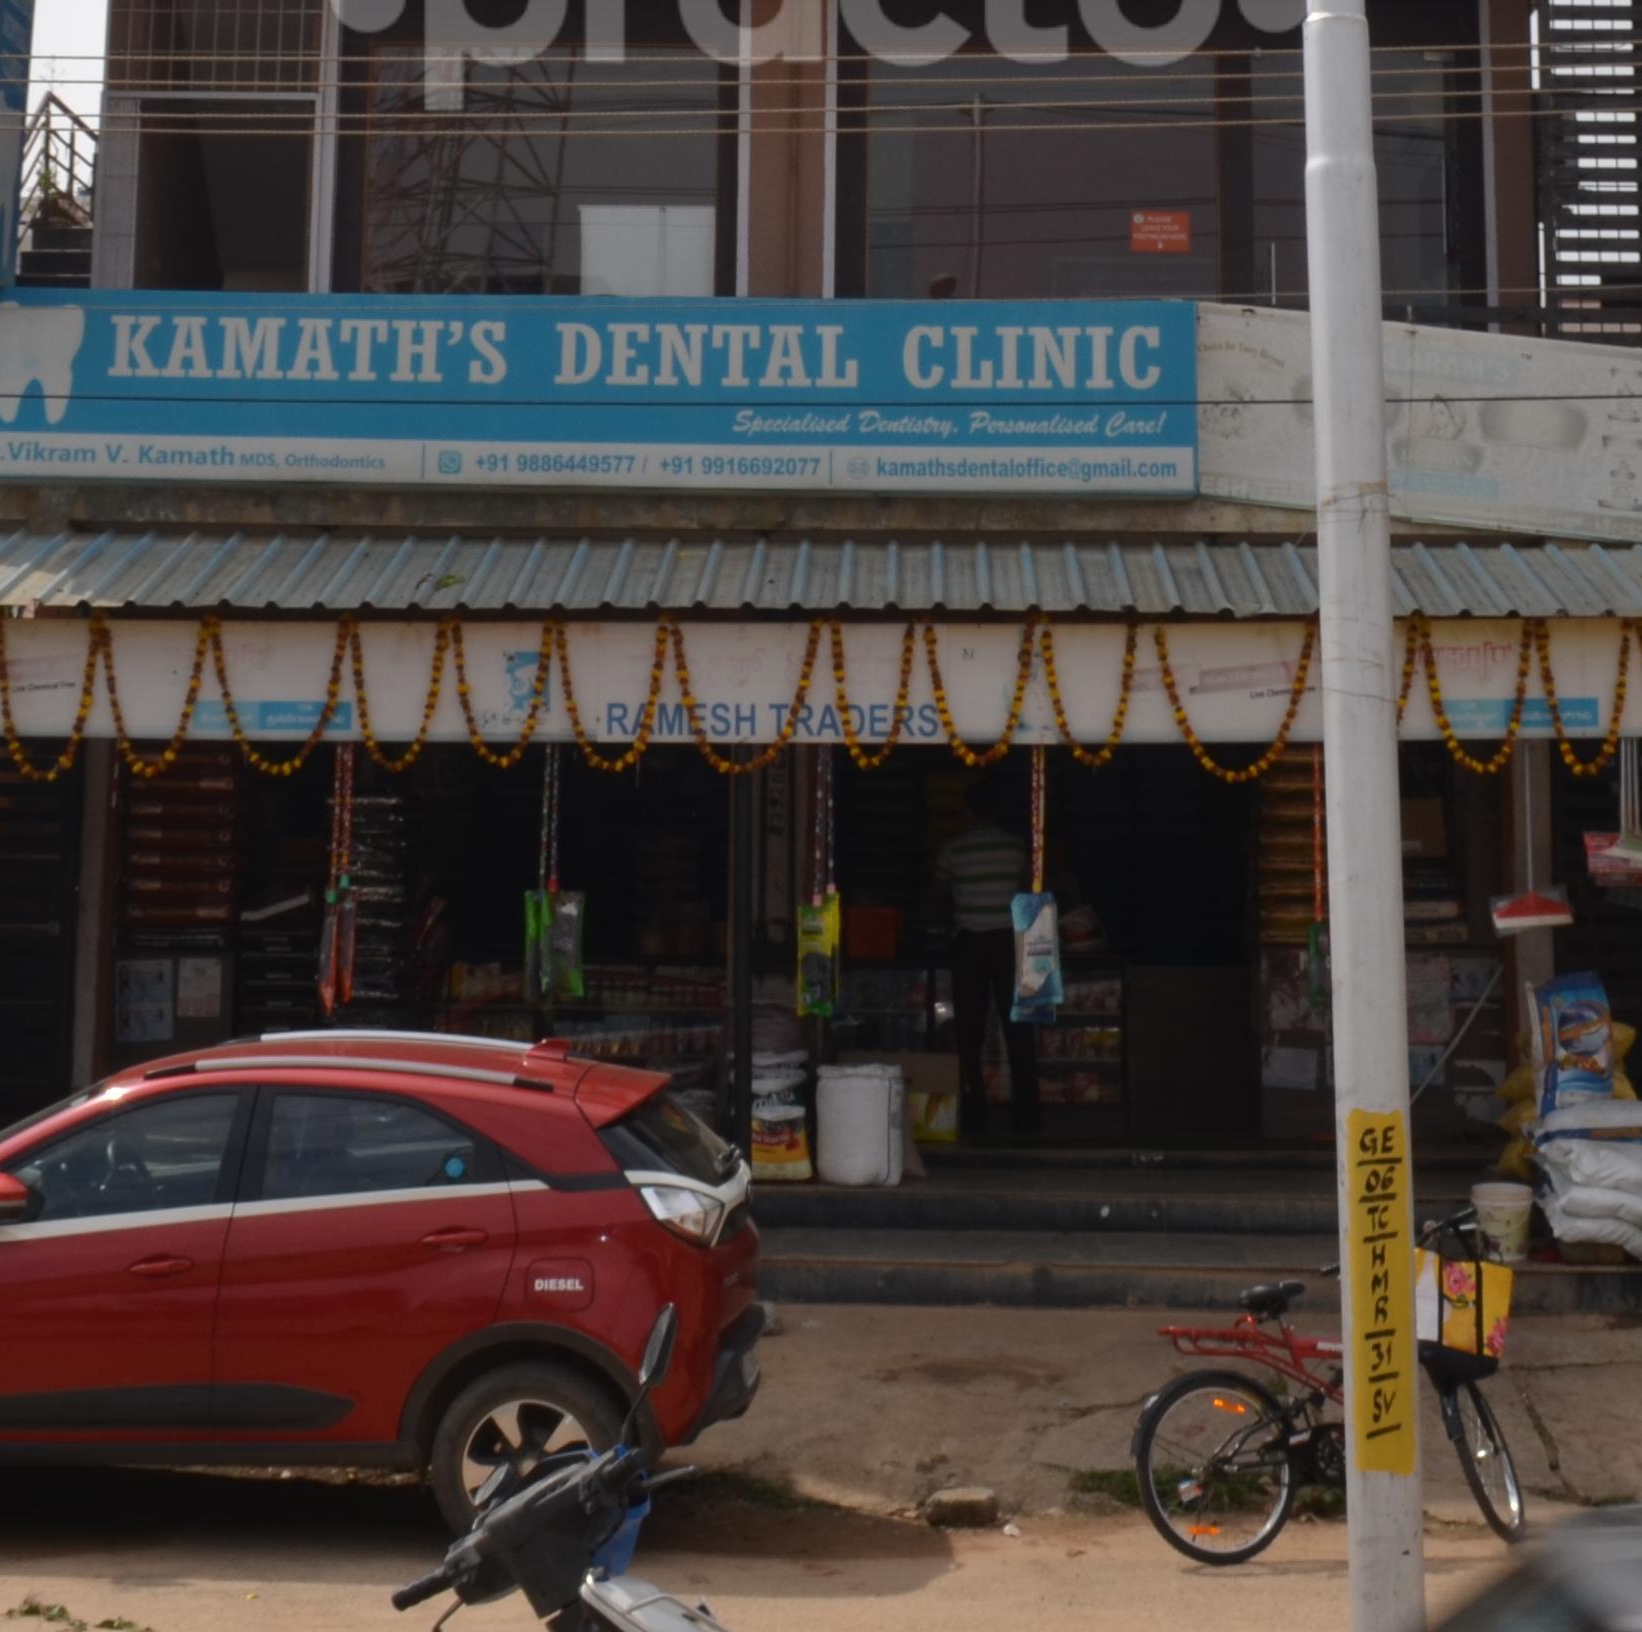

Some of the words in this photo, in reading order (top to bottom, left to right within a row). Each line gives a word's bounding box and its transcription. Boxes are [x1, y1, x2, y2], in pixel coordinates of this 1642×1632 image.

[107, 313, 506, 385] KAMATH'S
[555, 322, 858, 387] DENTAL
[902, 324, 1161, 389] CLINIC
[733, 410, 850, 435] Specialised
[969, 411, 1099, 437] Personalised
[1106, 412, 1168, 437] Care!
[105, 444, 130, 466] V.
[138, 444, 234, 467] Kamath
[284, 451, 385, 470] Orthodontics
[475, 452, 510, 473] +91
[517, 453, 636, 474] 9886449577
[660, 457, 694, 476] +91
[702, 457, 821, 477] 9916692077
[876, 456, 1178, 480] kamathsdentaloffice@gmail.com
[606, 702, 756, 736] RAMESH
[769, 703, 941, 737] TRADERS
[1359, 1125, 1396, 1155] GE
[1366, 1205, 1390, 1232] TC
[534, 1278, 584, 1292] DIESEL
